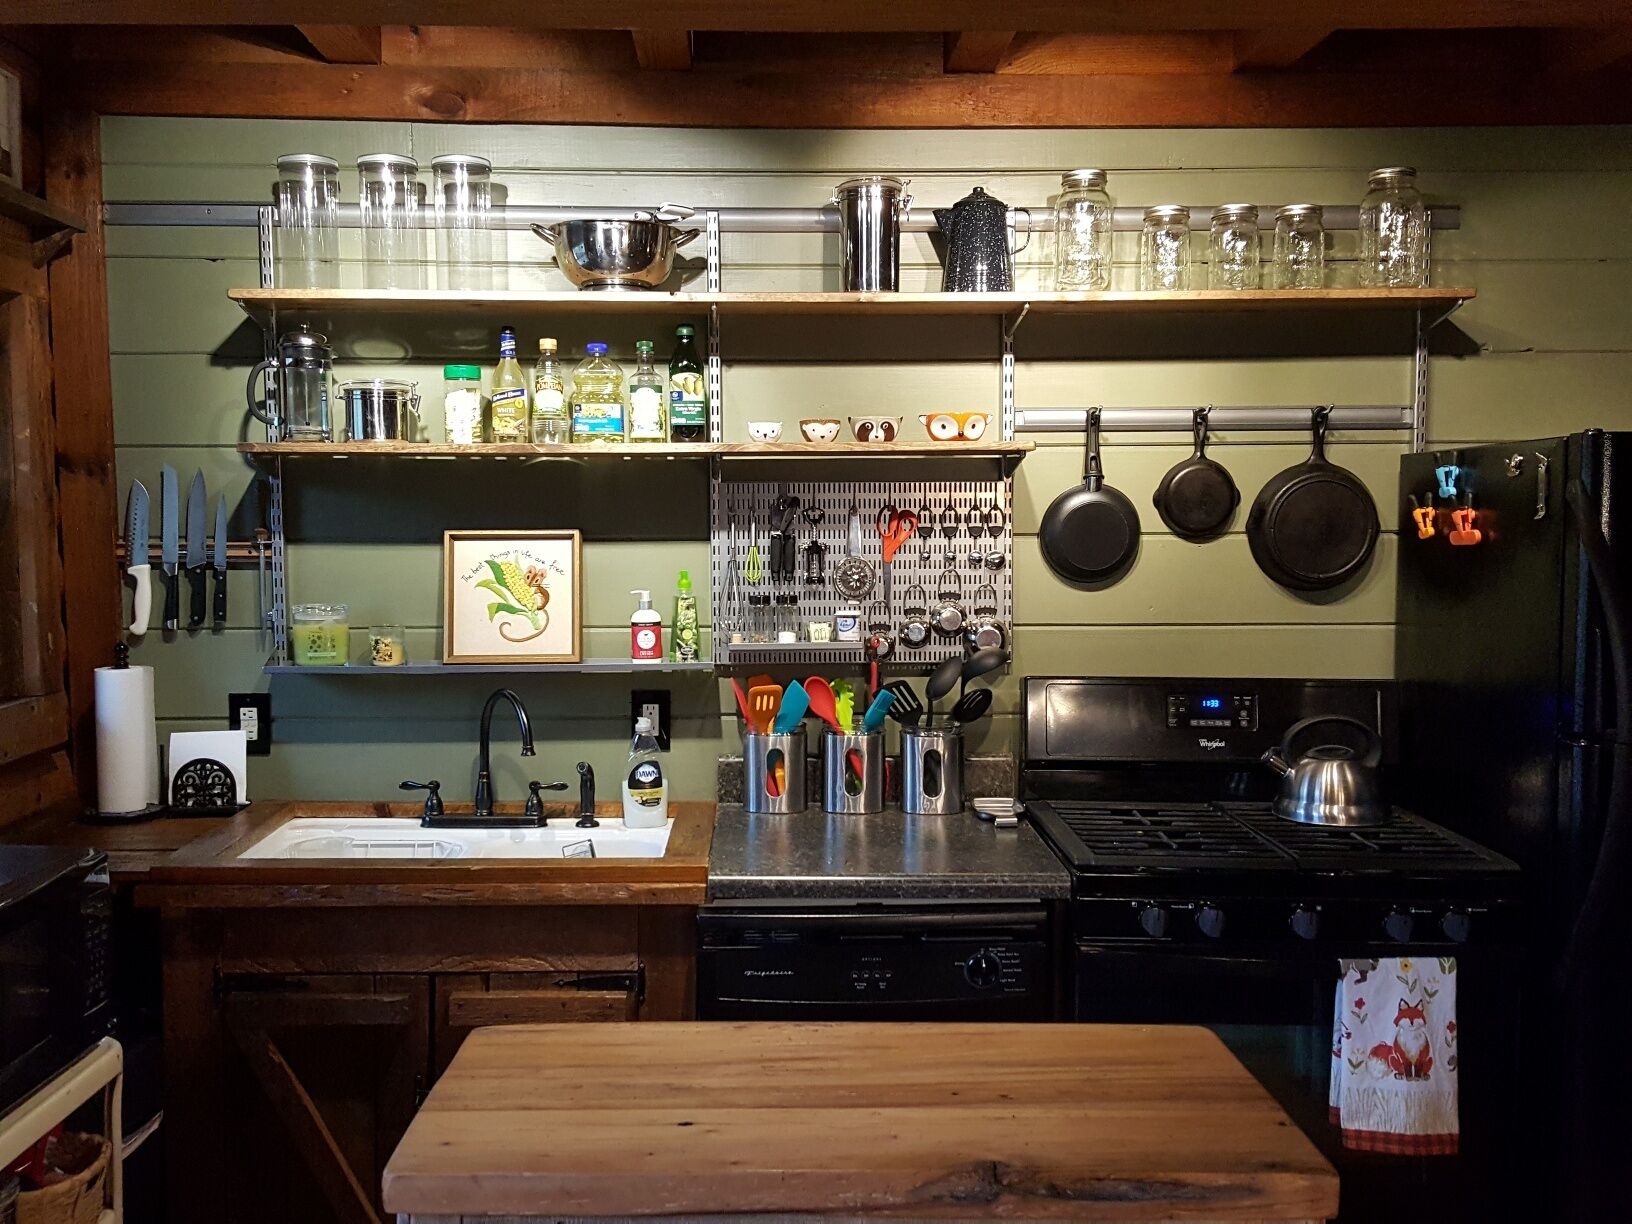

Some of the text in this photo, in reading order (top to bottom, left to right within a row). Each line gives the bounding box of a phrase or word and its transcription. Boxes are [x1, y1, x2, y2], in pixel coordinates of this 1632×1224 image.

[461, 574, 473, 583] The
[473, 562, 485, 575] best
[489, 550, 511, 561] things
[535, 557, 546, 565] are
[549, 560, 565, 576] free
[1199, 738, 1226, 750] Whirlpool
[635, 769, 659, 779] DAWN
